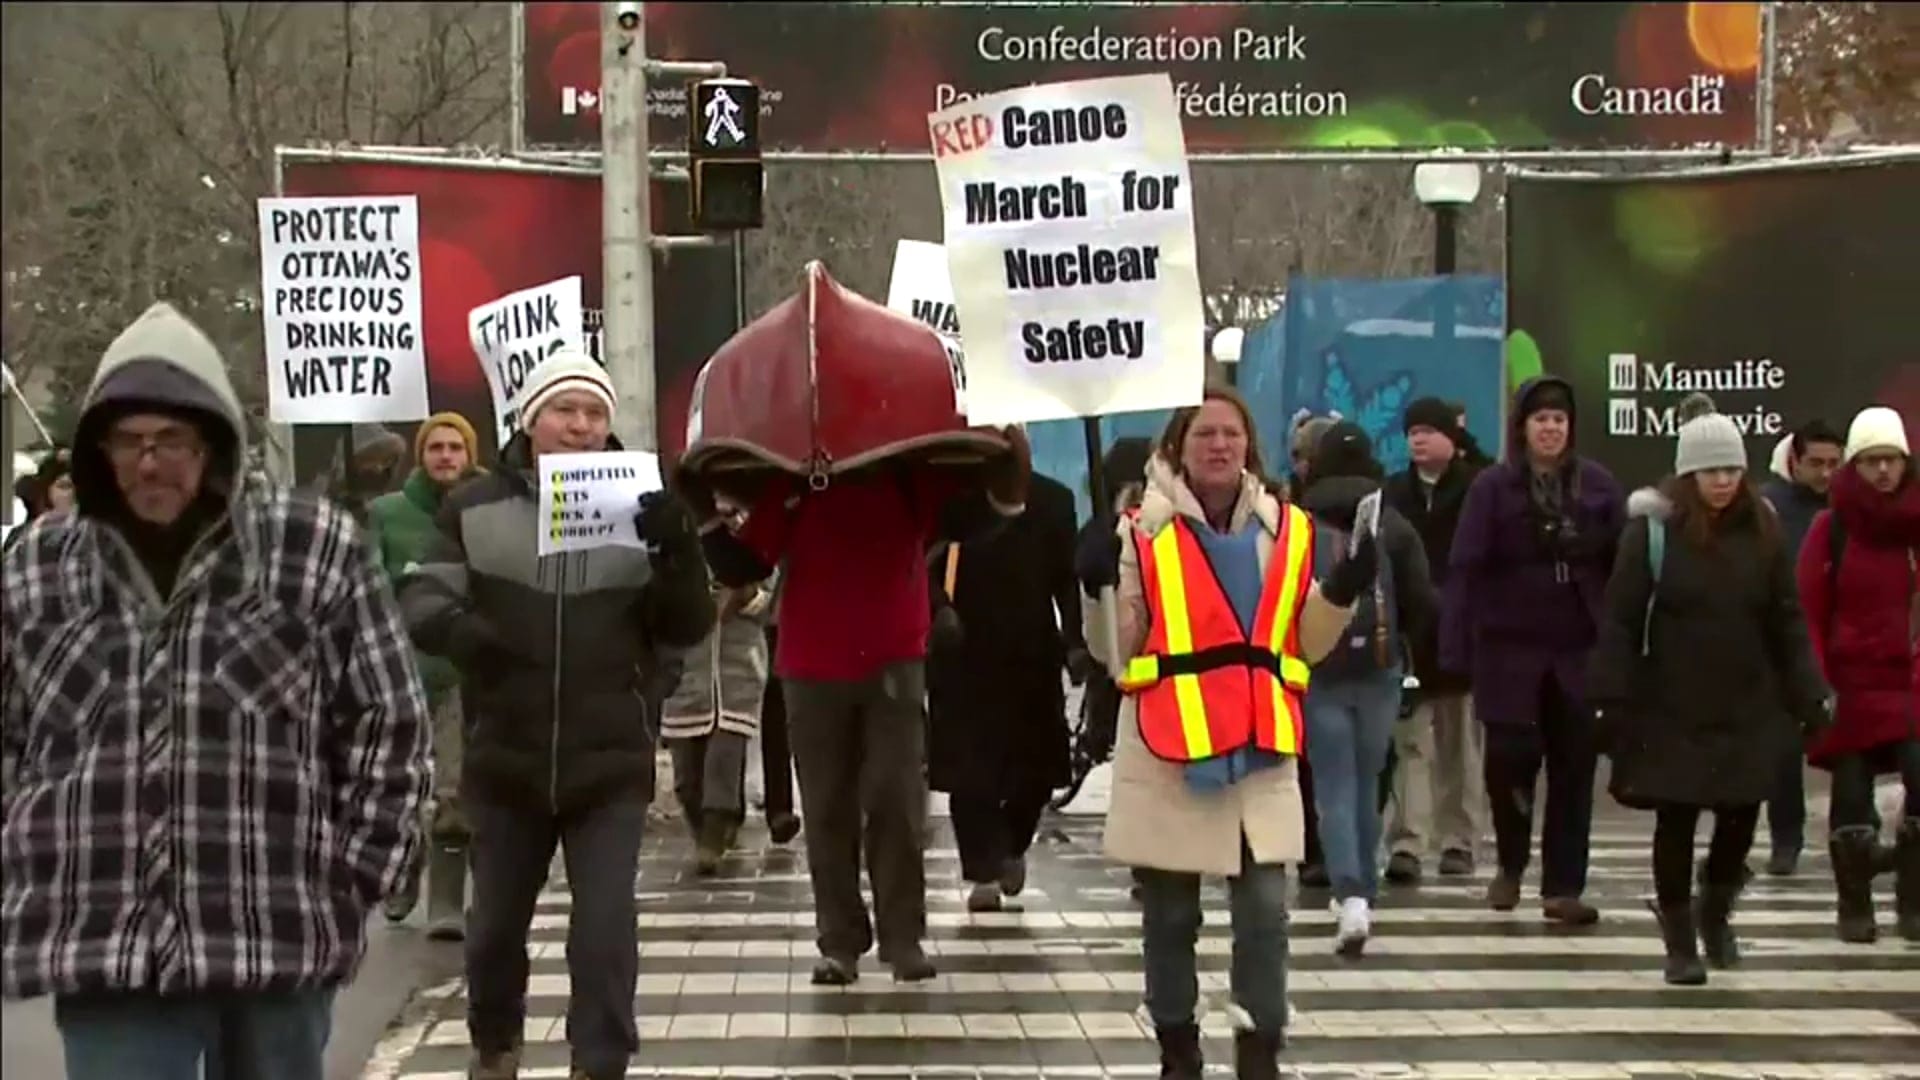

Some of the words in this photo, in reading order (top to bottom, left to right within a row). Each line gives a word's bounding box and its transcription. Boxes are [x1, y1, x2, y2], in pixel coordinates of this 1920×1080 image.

[978, 27, 1221, 61] Confederation
[1234, 27, 1306, 60] Park
[1176, 82, 1346, 117] fédération
[1571, 73, 1725, 116] Canada
[931, 113, 994, 158] RED
[1002, 103, 1128, 149] Canoe
[964, 176, 1087, 225] March
[1121, 169, 1180, 213] for
[272, 205, 401, 244] PROTECT
[281, 246, 412, 282] OTTAWA'S
[1004, 245, 1160, 291] Nuclear
[275, 286, 404, 316] PRECIOUS
[286, 321, 414, 352] DRINKING
[477, 293, 560, 355] THINK
[1021, 318, 1145, 365] Safety
[283, 355, 393, 399] WATER
[1643, 358, 1786, 392] Manulife
[1643, 405, 1783, 437] Mvie
[551, 467, 636, 483] COMPLETELY
